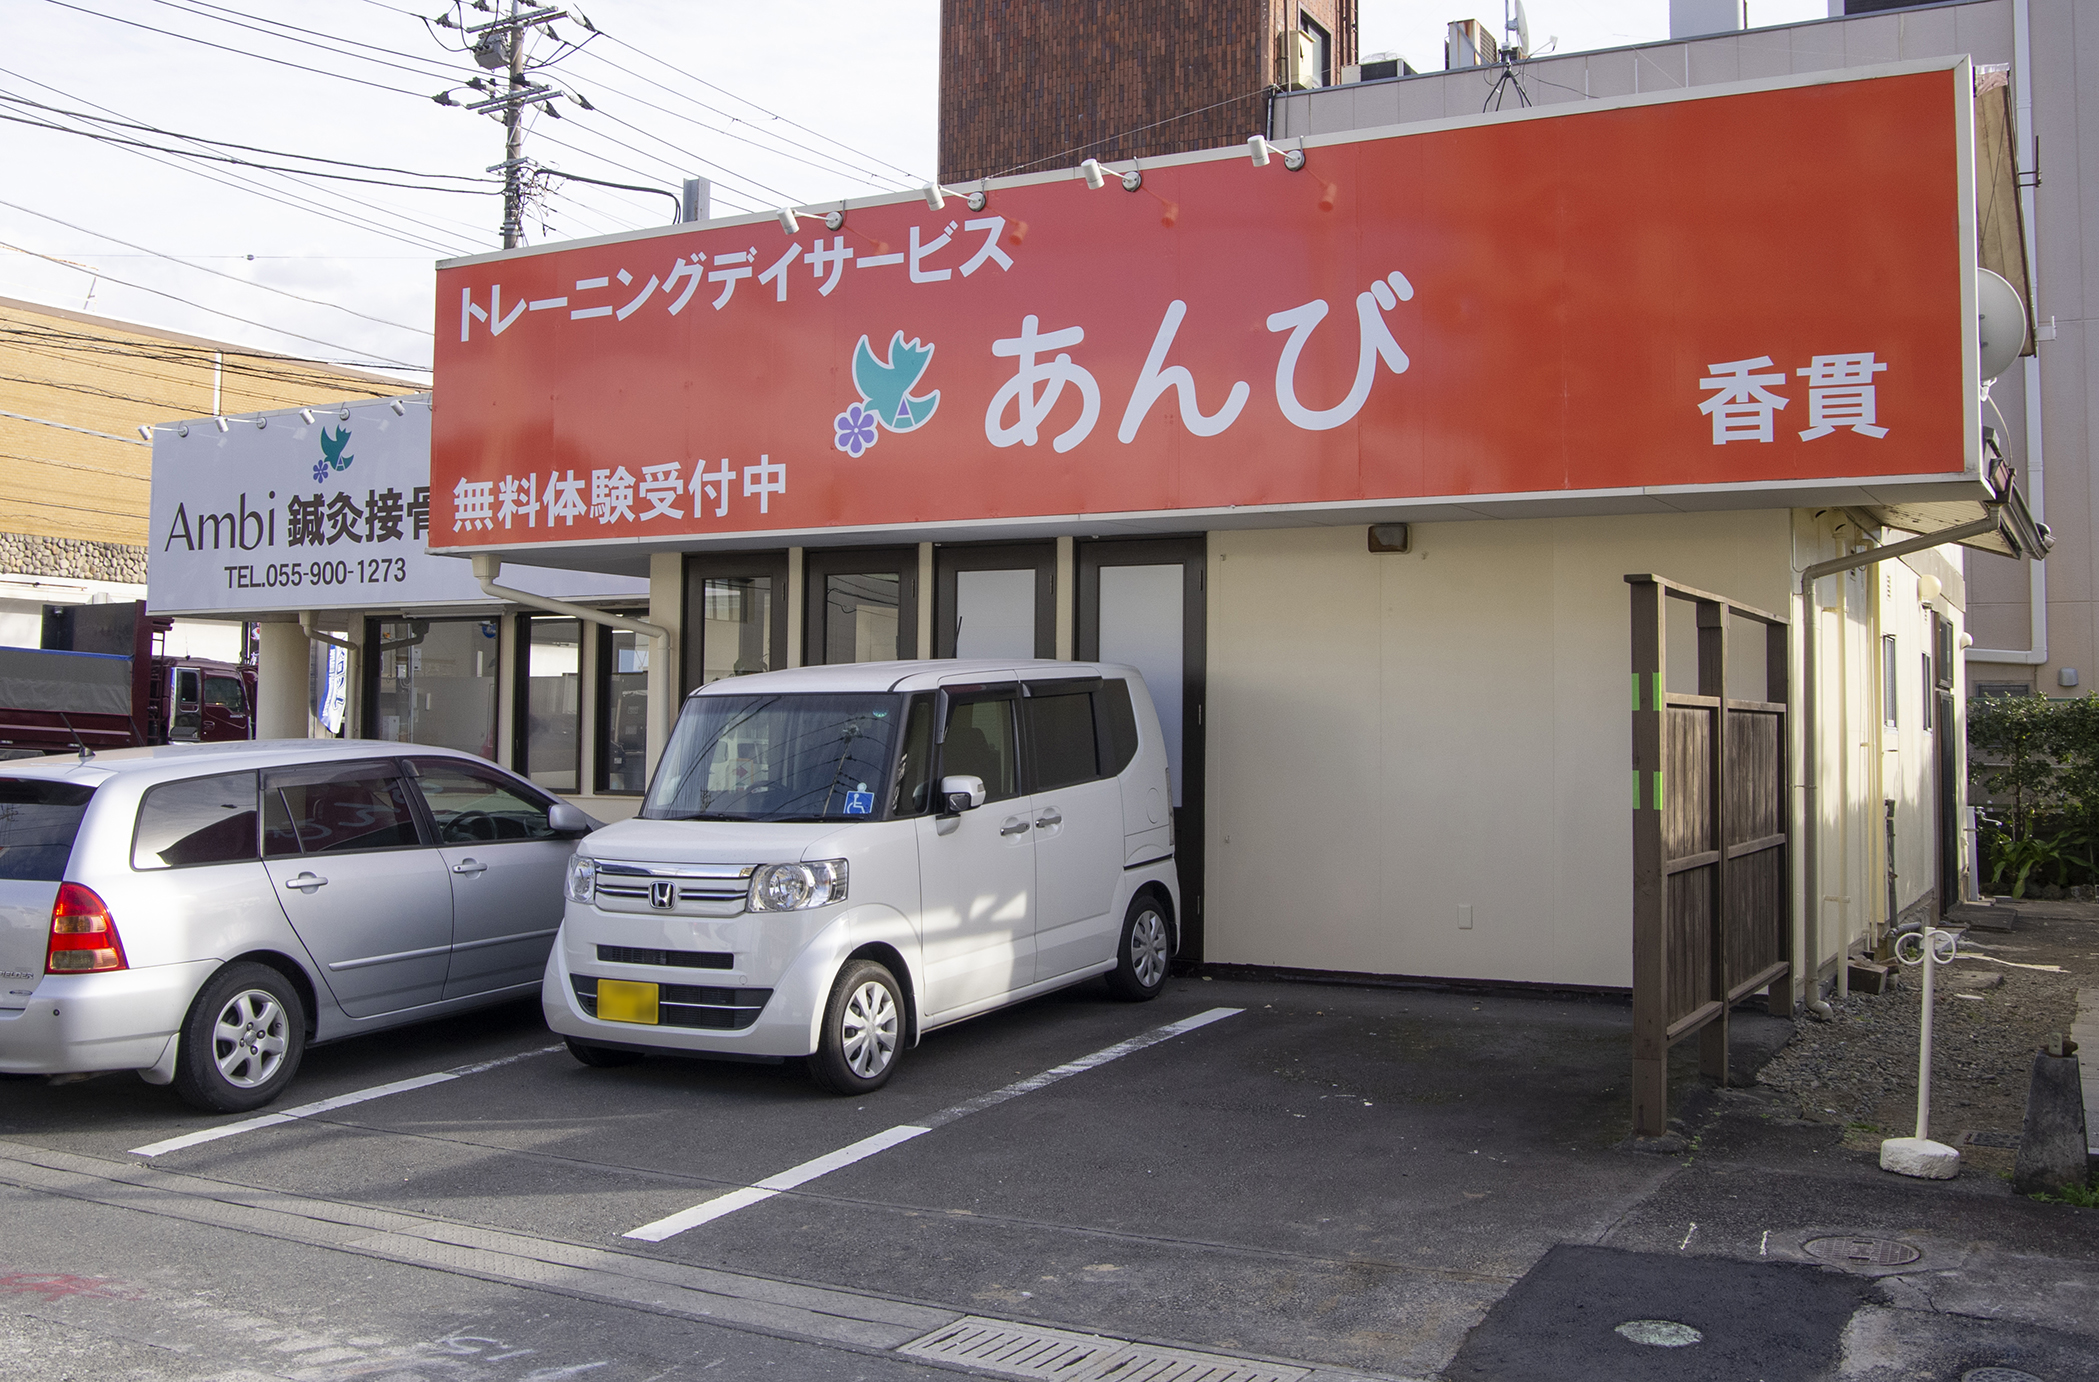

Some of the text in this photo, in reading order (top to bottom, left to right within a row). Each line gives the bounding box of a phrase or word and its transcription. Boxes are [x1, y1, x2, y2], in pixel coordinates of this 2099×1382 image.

[461, 215, 1014, 342] トレーニングデイサービス
[985, 271, 1413, 454] あんび
[1697, 352, 1889, 445] 香貫
[164, 490, 276, 552] Ambi
[452, 454, 787, 532] 無料体験受付中
[224, 557, 407, 589] TEL.055-900-1273
